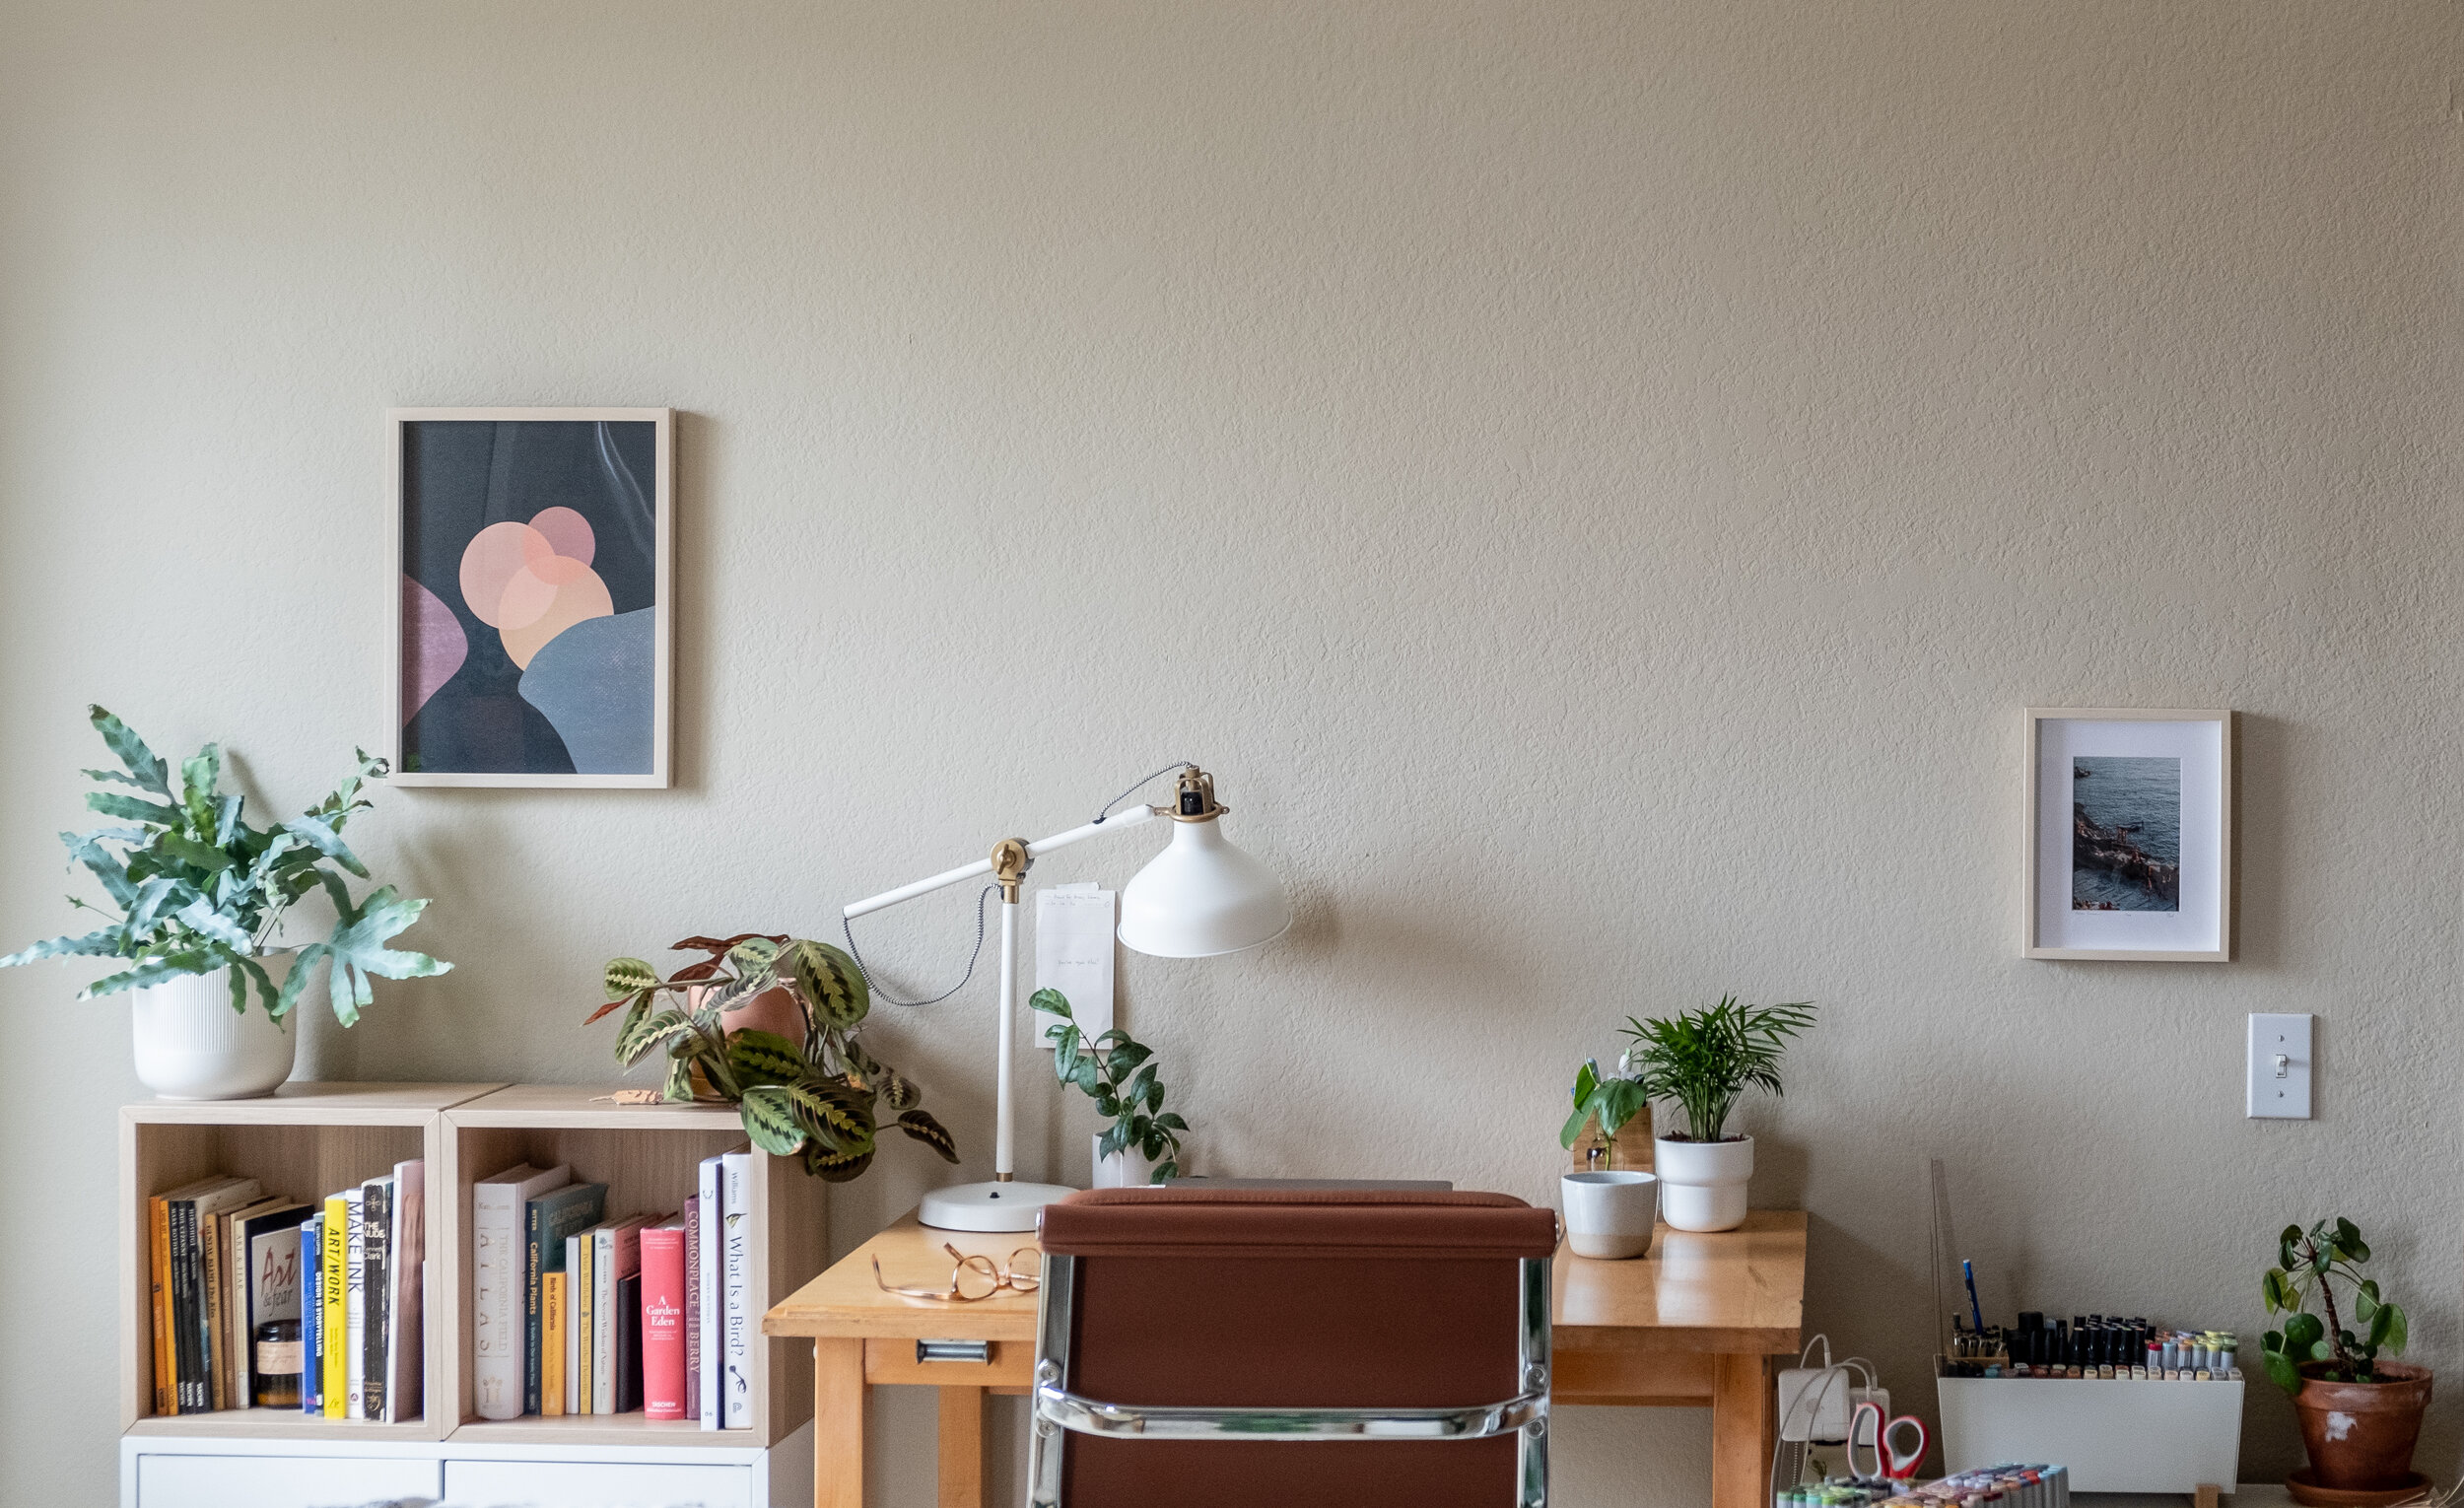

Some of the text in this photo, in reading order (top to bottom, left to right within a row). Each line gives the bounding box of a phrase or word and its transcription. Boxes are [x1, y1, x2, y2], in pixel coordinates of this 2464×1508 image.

[730, 1172, 740, 1204] Williams
[347, 1201, 364, 1255] MAKE
[363, 1229, 385, 1238] NUDE
[364, 1221, 379, 1230] THE
[237, 1256, 243, 1268] &
[261, 1246, 297, 1297] Art
[327, 1227, 341, 1307] ART/WORK
[688, 1211, 699, 1308] COMMONPLACE
[729, 1236, 744, 1278] What
[347, 1262, 364, 1293] INK
[479, 1233, 496, 1352] ATLAS
[498, 1234, 509, 1351] THE CALIFORNIA FIELD
[529, 1242, 539, 1315] California Plants
[730, 1285, 743, 1297] Is
[646, 1304, 680, 1316] Garden
[657, 1295, 666, 1305] A
[650, 1315, 675, 1327] Eden
[730, 1316, 745, 1356] Bird?
[689, 1332, 700, 1373] BERRY
